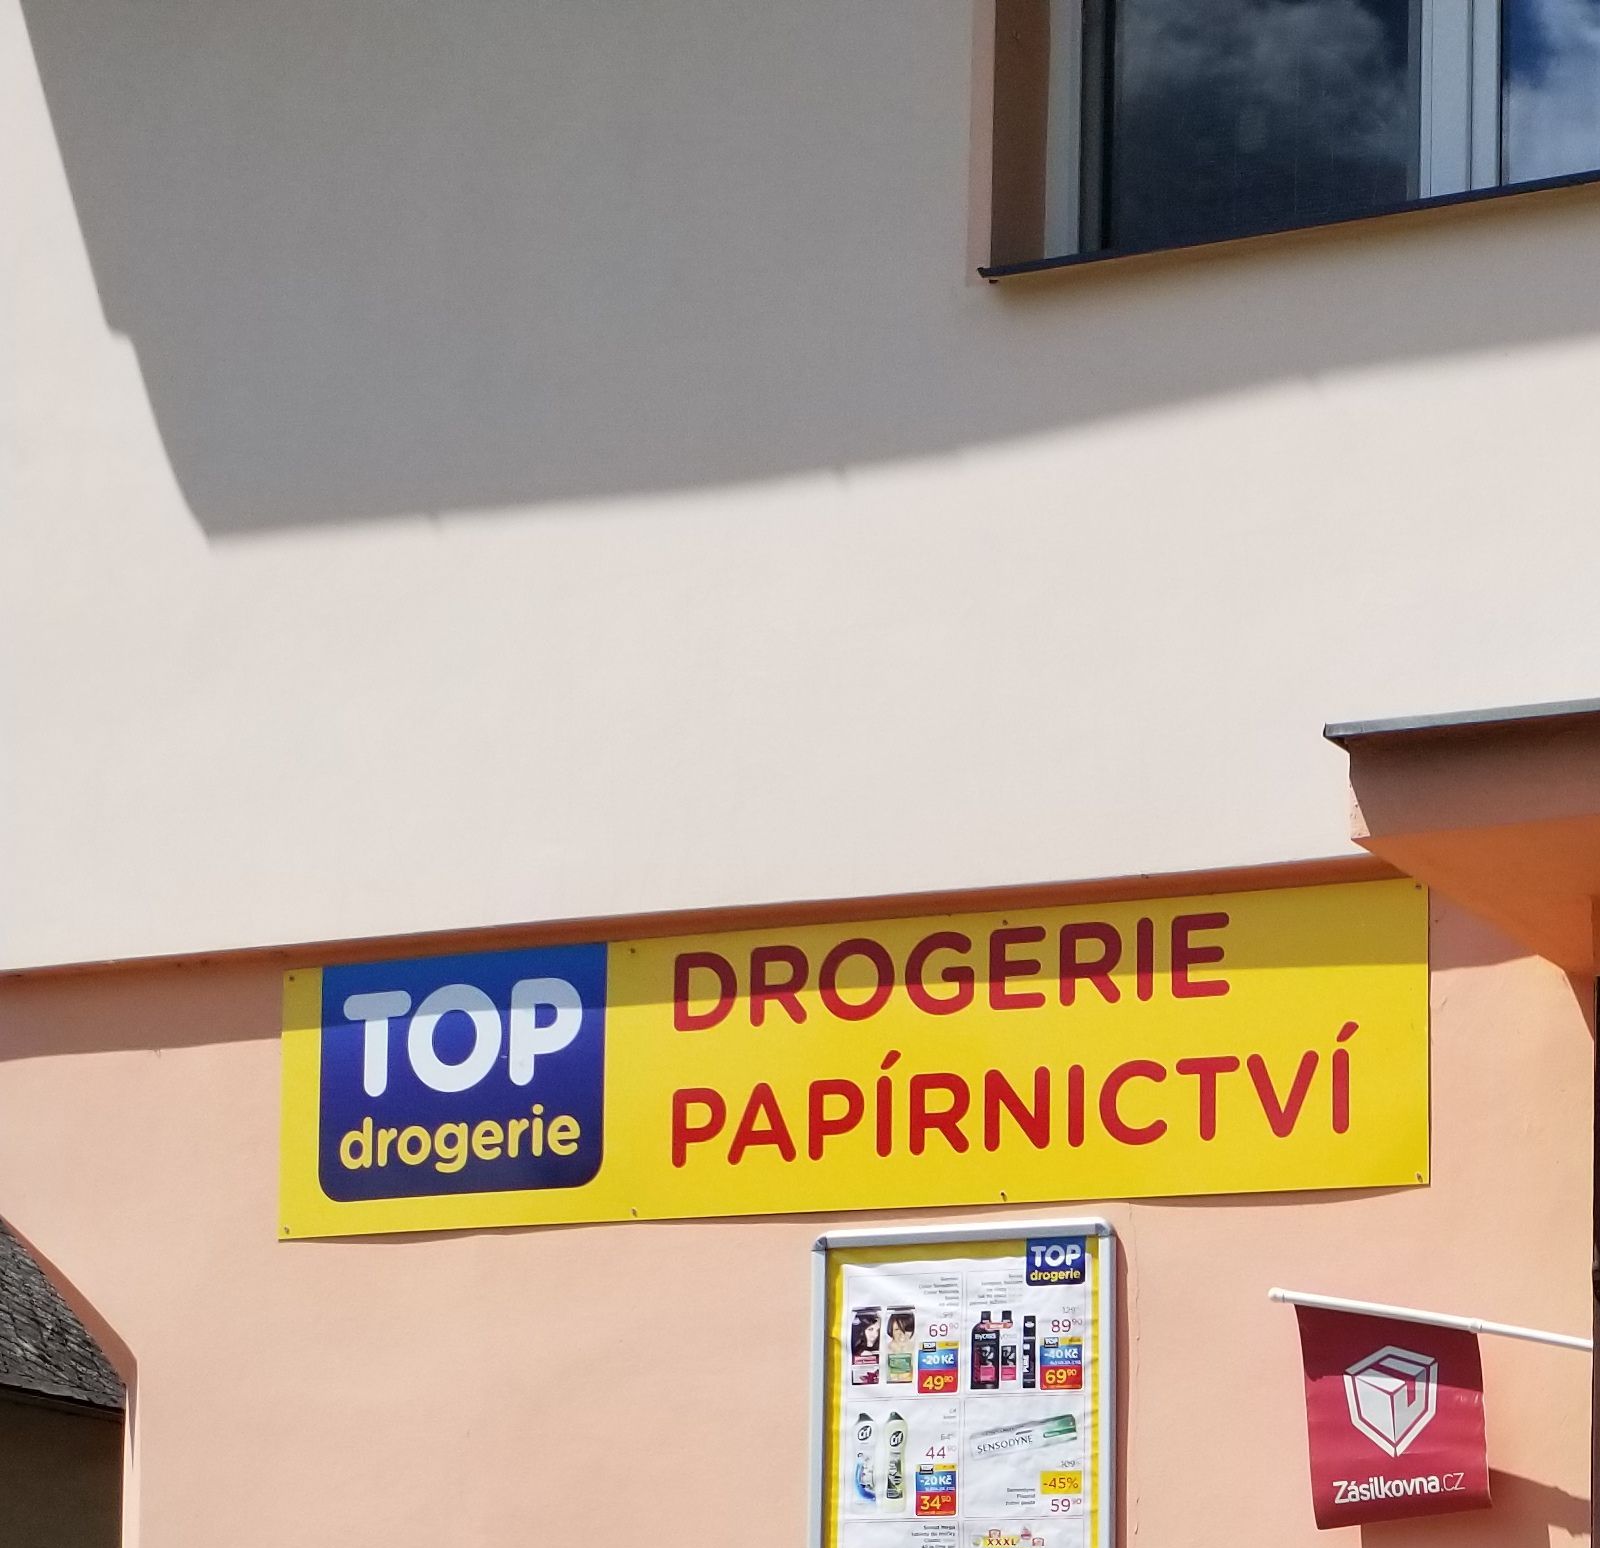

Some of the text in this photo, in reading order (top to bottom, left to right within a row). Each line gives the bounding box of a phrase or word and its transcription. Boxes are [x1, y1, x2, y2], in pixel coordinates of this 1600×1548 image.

[672, 911, 1231, 1035] DROGERIE
[342, 976, 584, 1099] TOP
[670, 1020, 1361, 1170] PAPÍRNICTVÍ
[339, 1103, 582, 1175] drogerie
[1030, 1244, 1082, 1268] TOP
[1029, 1269, 1081, 1282] drogerie
[976, 1435, 1033, 1455] SENSODYNE
[1043, 1477, 1079, 1490] -45%
[987, 1538, 1016, 1547] XXXL
